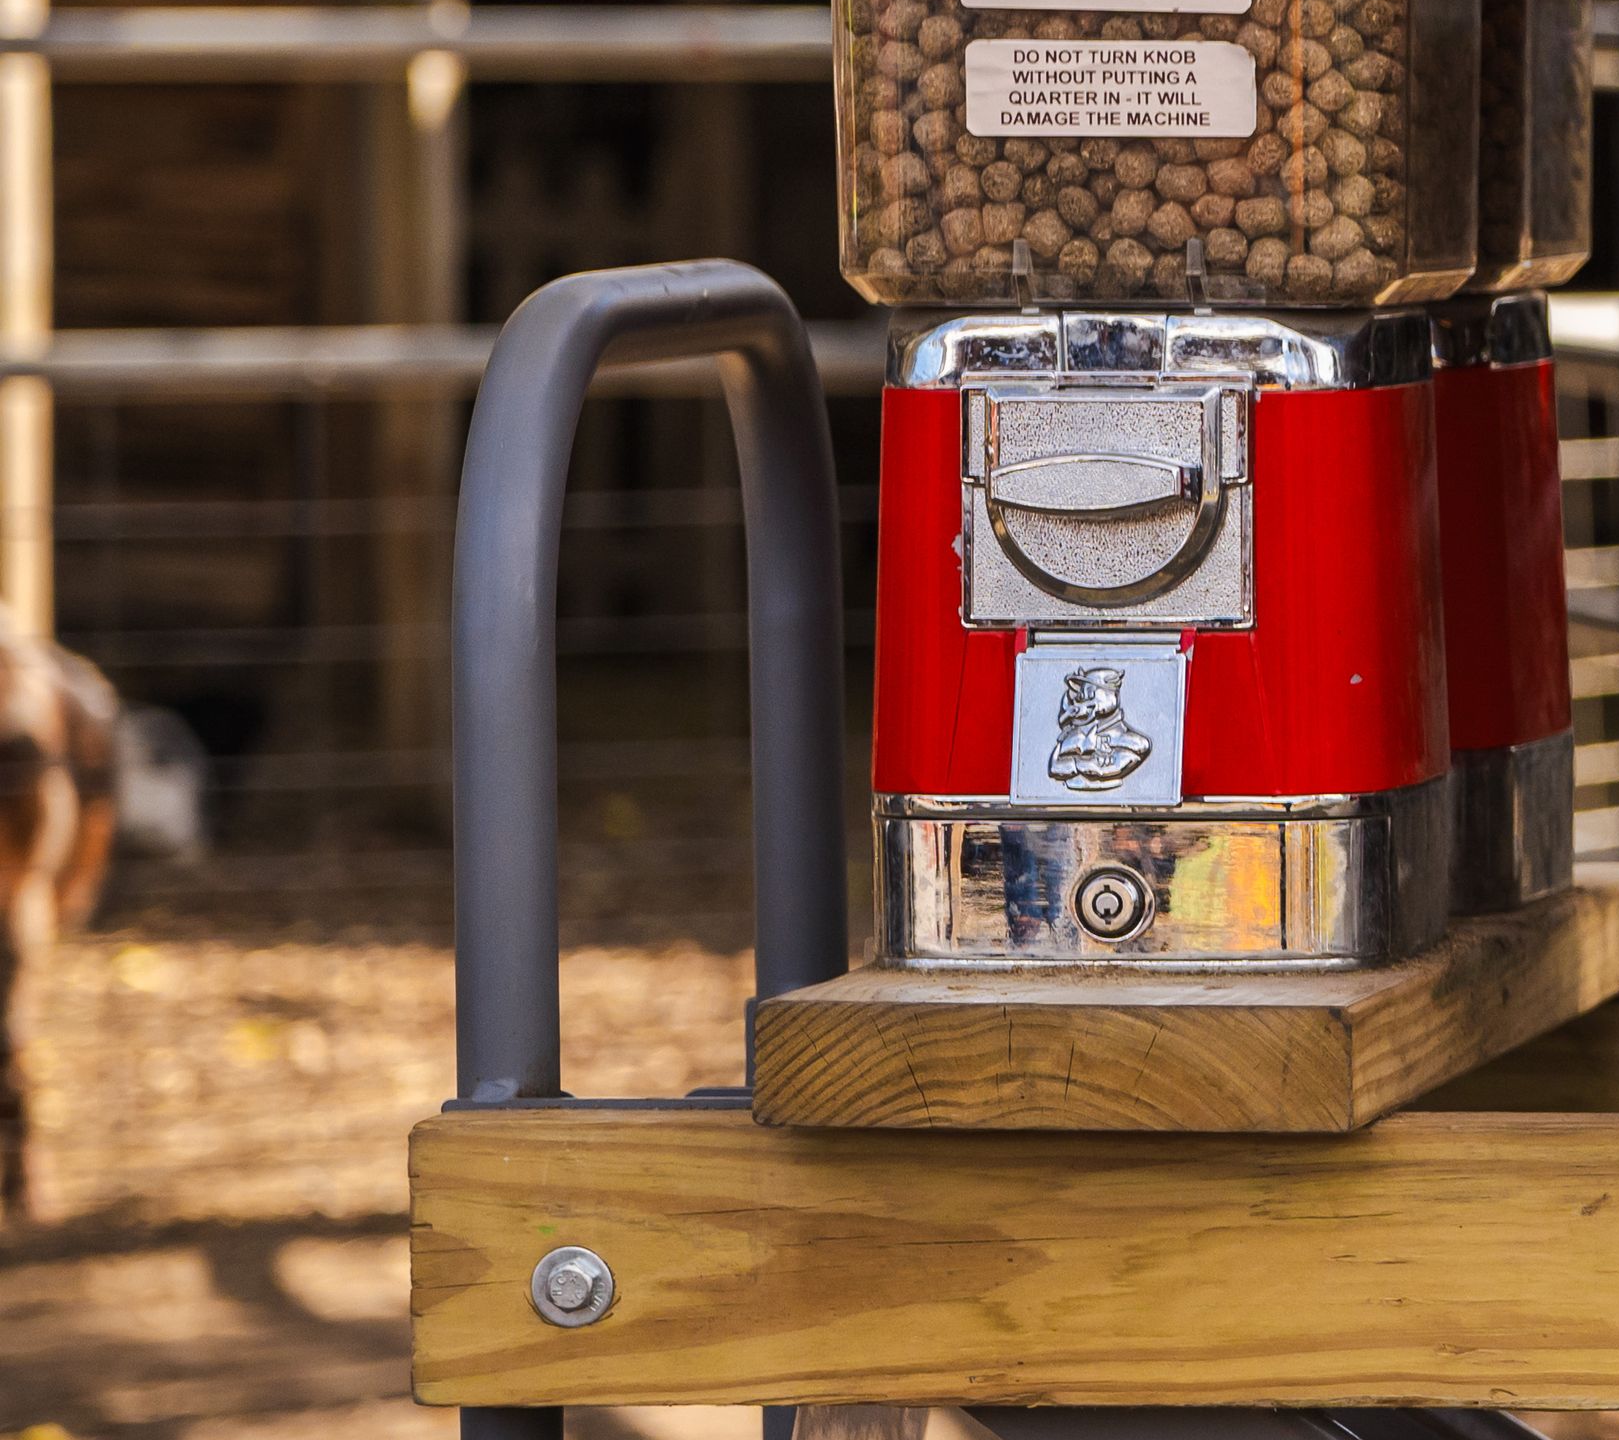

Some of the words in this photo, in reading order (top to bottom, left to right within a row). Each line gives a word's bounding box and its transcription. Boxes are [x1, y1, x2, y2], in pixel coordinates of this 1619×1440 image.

[1013, 49, 1040, 65] DO
[1045, 49, 1084, 65] NOT
[1088, 49, 1137, 65] TURN
[1143, 49, 1197, 65] KNOB
[1011, 69, 1097, 85] WITHOUT
[1102, 69, 1180, 86] PUTTING
[1184, 70, 1198, 86] A
[1008, 89, 1098, 106] QUARTER
[1103, 90, 1121, 106] IN
[1137, 91, 1153, 106] IT
[1156, 91, 1202, 106] WILL
[1000, 111, 1081, 127] DAMAGE
[1085, 111, 1122, 126] THE
[1126, 111, 1211, 127] MACHINE
